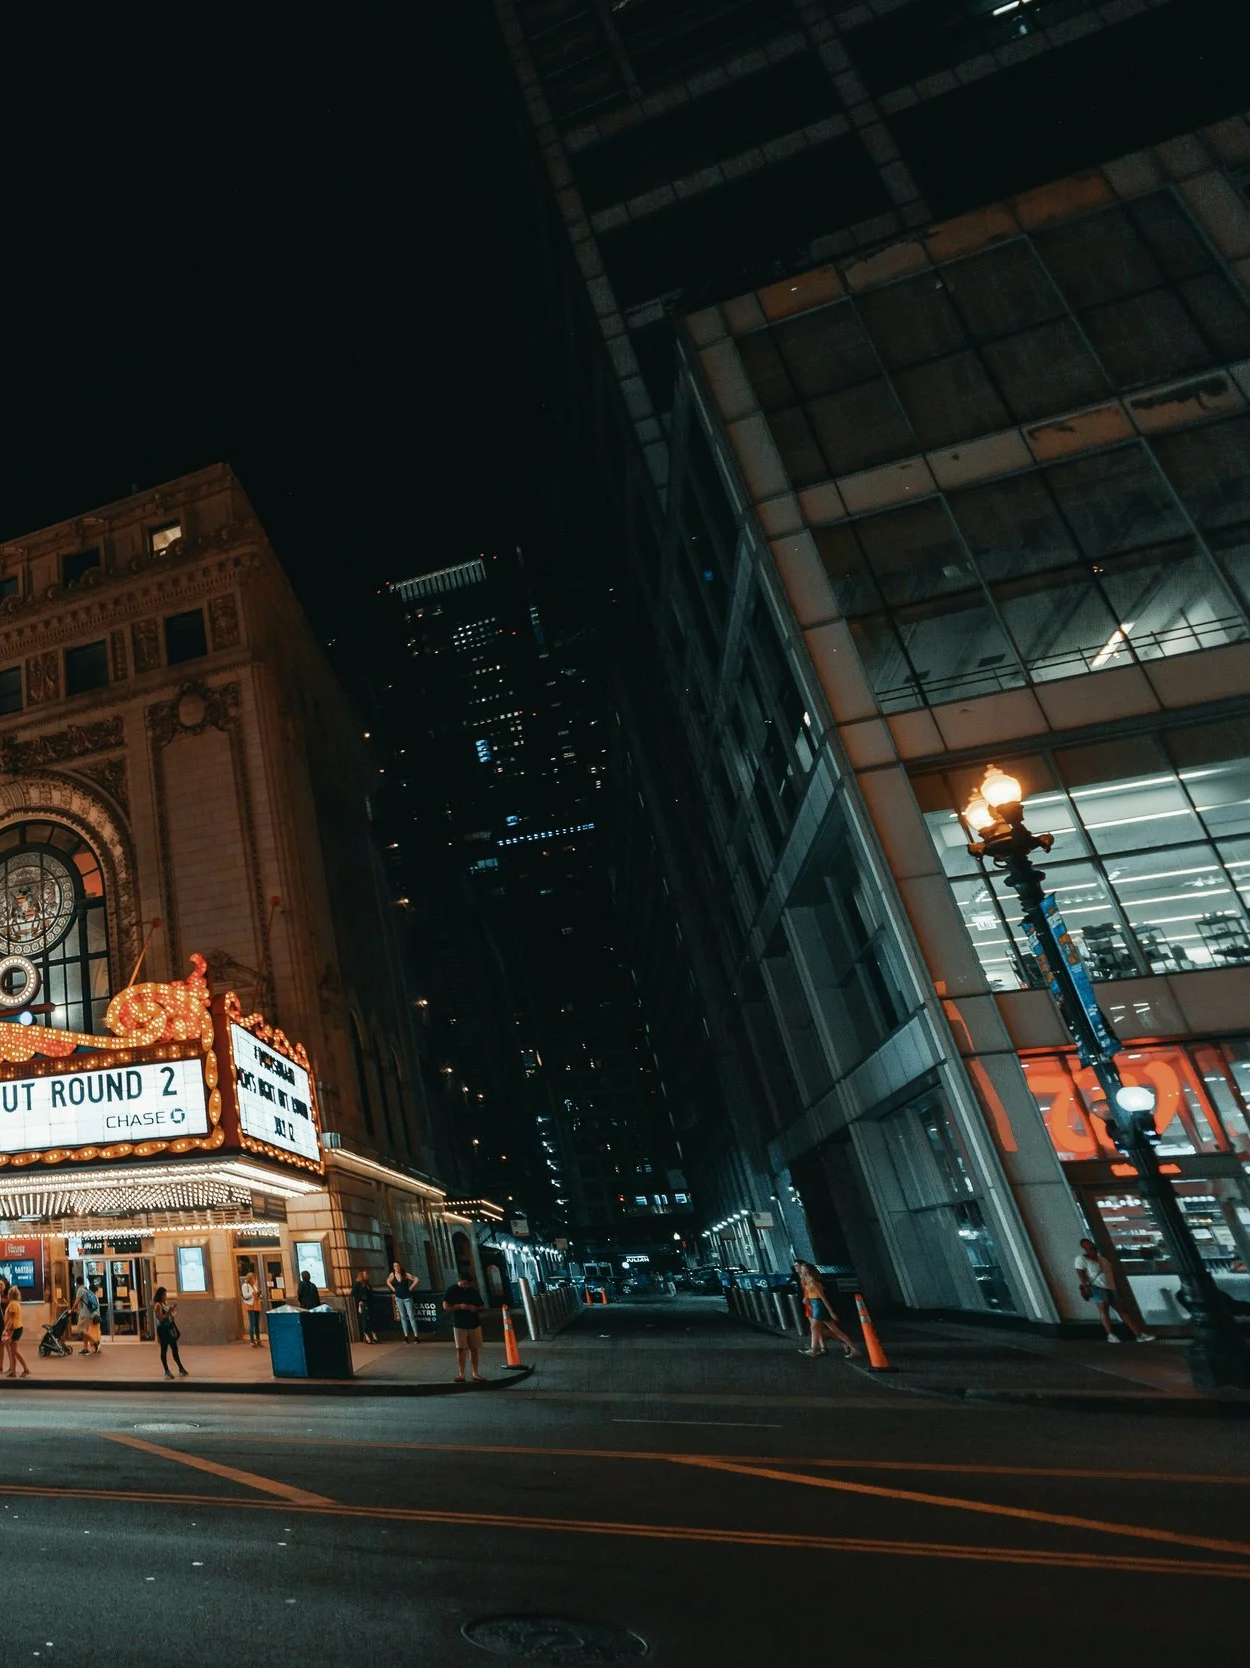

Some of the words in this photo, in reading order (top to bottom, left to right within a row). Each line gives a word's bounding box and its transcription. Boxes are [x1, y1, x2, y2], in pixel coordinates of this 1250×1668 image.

[51, 1069, 143, 1109] ROUND
[159, 1066, 178, 1097] 2
[106, 1111, 166, 1129] CHASE
